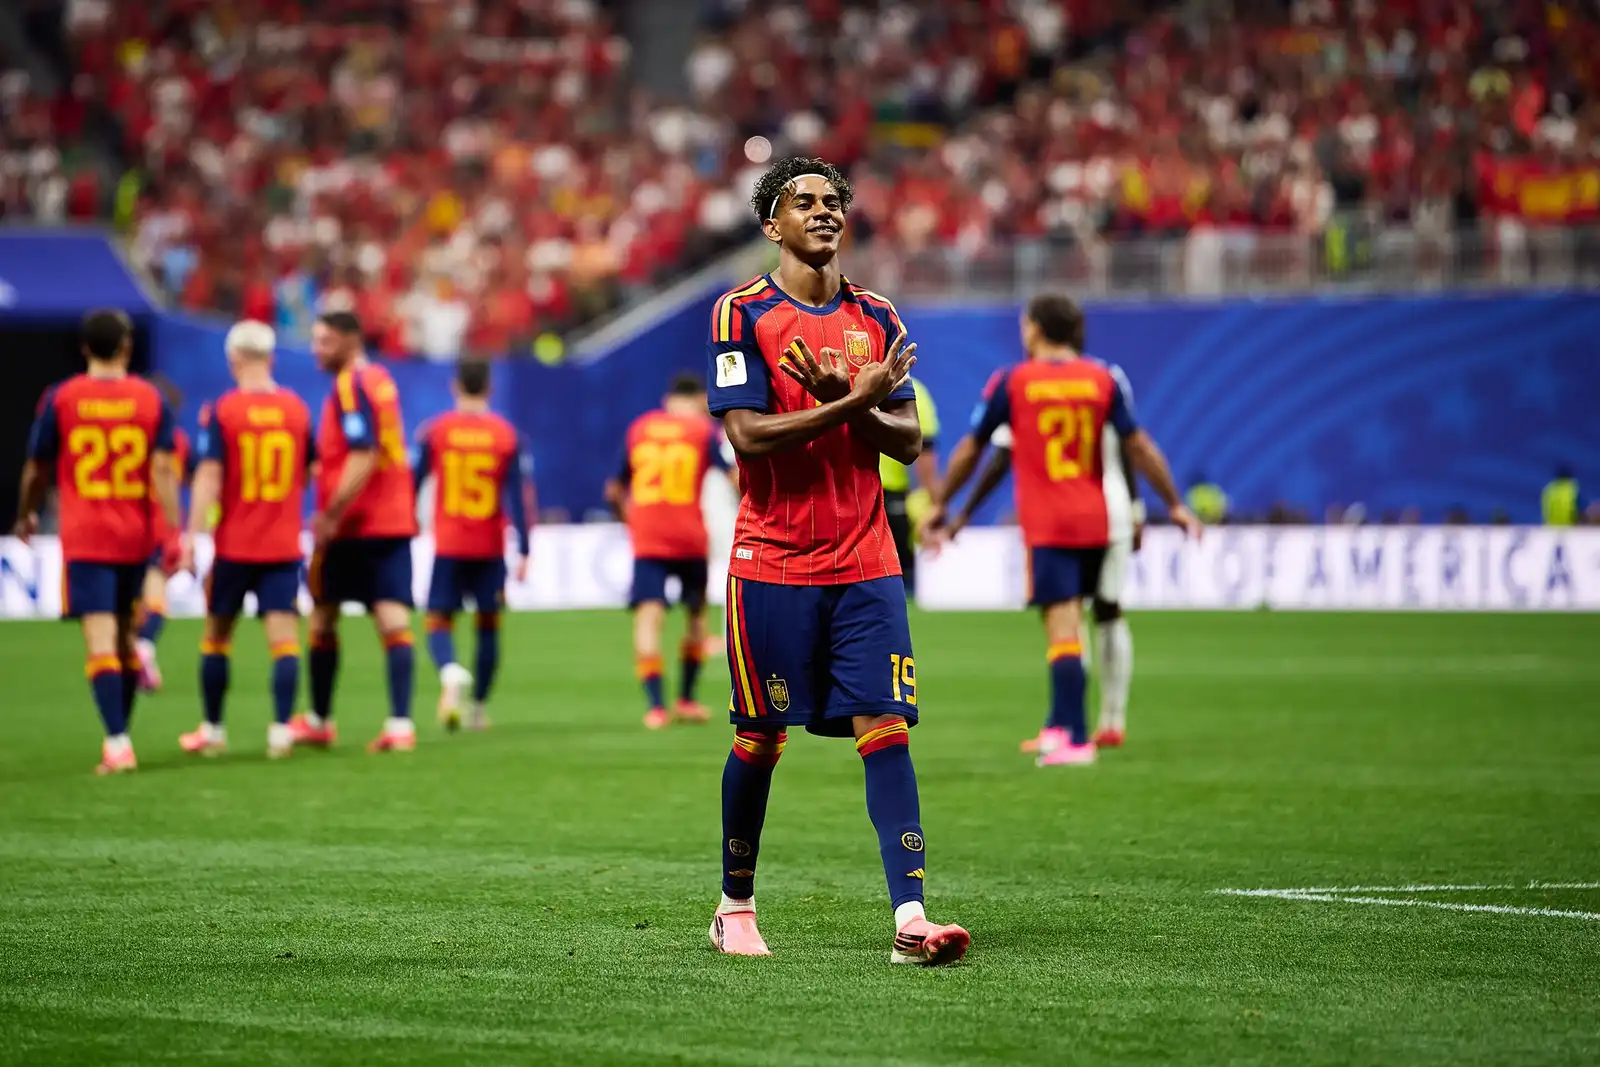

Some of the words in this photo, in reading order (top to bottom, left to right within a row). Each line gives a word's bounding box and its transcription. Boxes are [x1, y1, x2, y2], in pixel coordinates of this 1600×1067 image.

[69, 424, 147, 499] 22
[238, 429, 294, 503] 10
[630, 440, 698, 505] 20
[1038, 405, 1094, 481] 21
[443, 450, 497, 519] 15
[1302, 531, 1579, 604] AMERICA
[890, 653, 917, 705] 19
